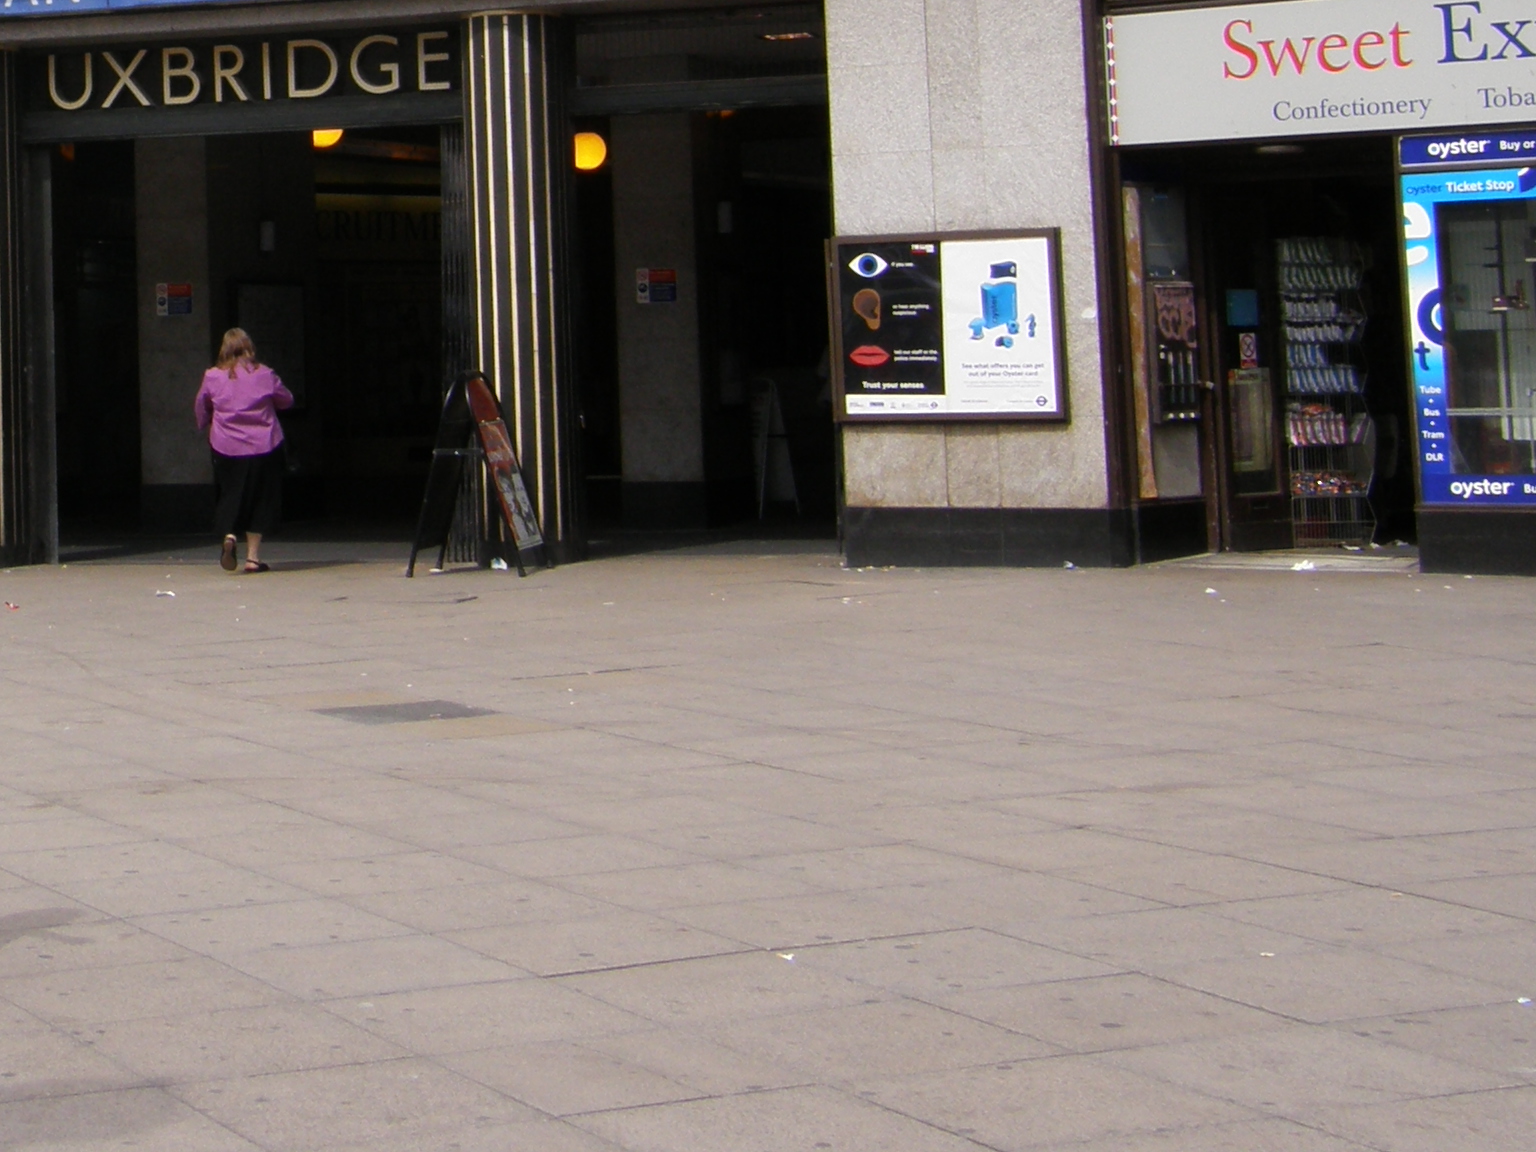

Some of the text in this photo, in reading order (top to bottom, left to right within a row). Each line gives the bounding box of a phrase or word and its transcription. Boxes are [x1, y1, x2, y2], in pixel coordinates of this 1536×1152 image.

[1223, 1, 1536, 80] Sweet Ex
[47, 30, 452, 111] UXBRIDGE
[1272, 96, 1433, 121] Confectionery
[1427, 138, 1536, 159] oyster Buy or
[1406, 179, 1515, 196] oyster Ticket Stop
[862, 381, 881, 389] Trust
[882, 382, 898, 390] your
[1419, 385, 1442, 394] Tube
[1423, 408, 1441, 417] Bus
[1421, 430, 1445, 439] Tram
[1425, 453, 1444, 462] DLR
[1450, 478, 1511, 499] oyster
